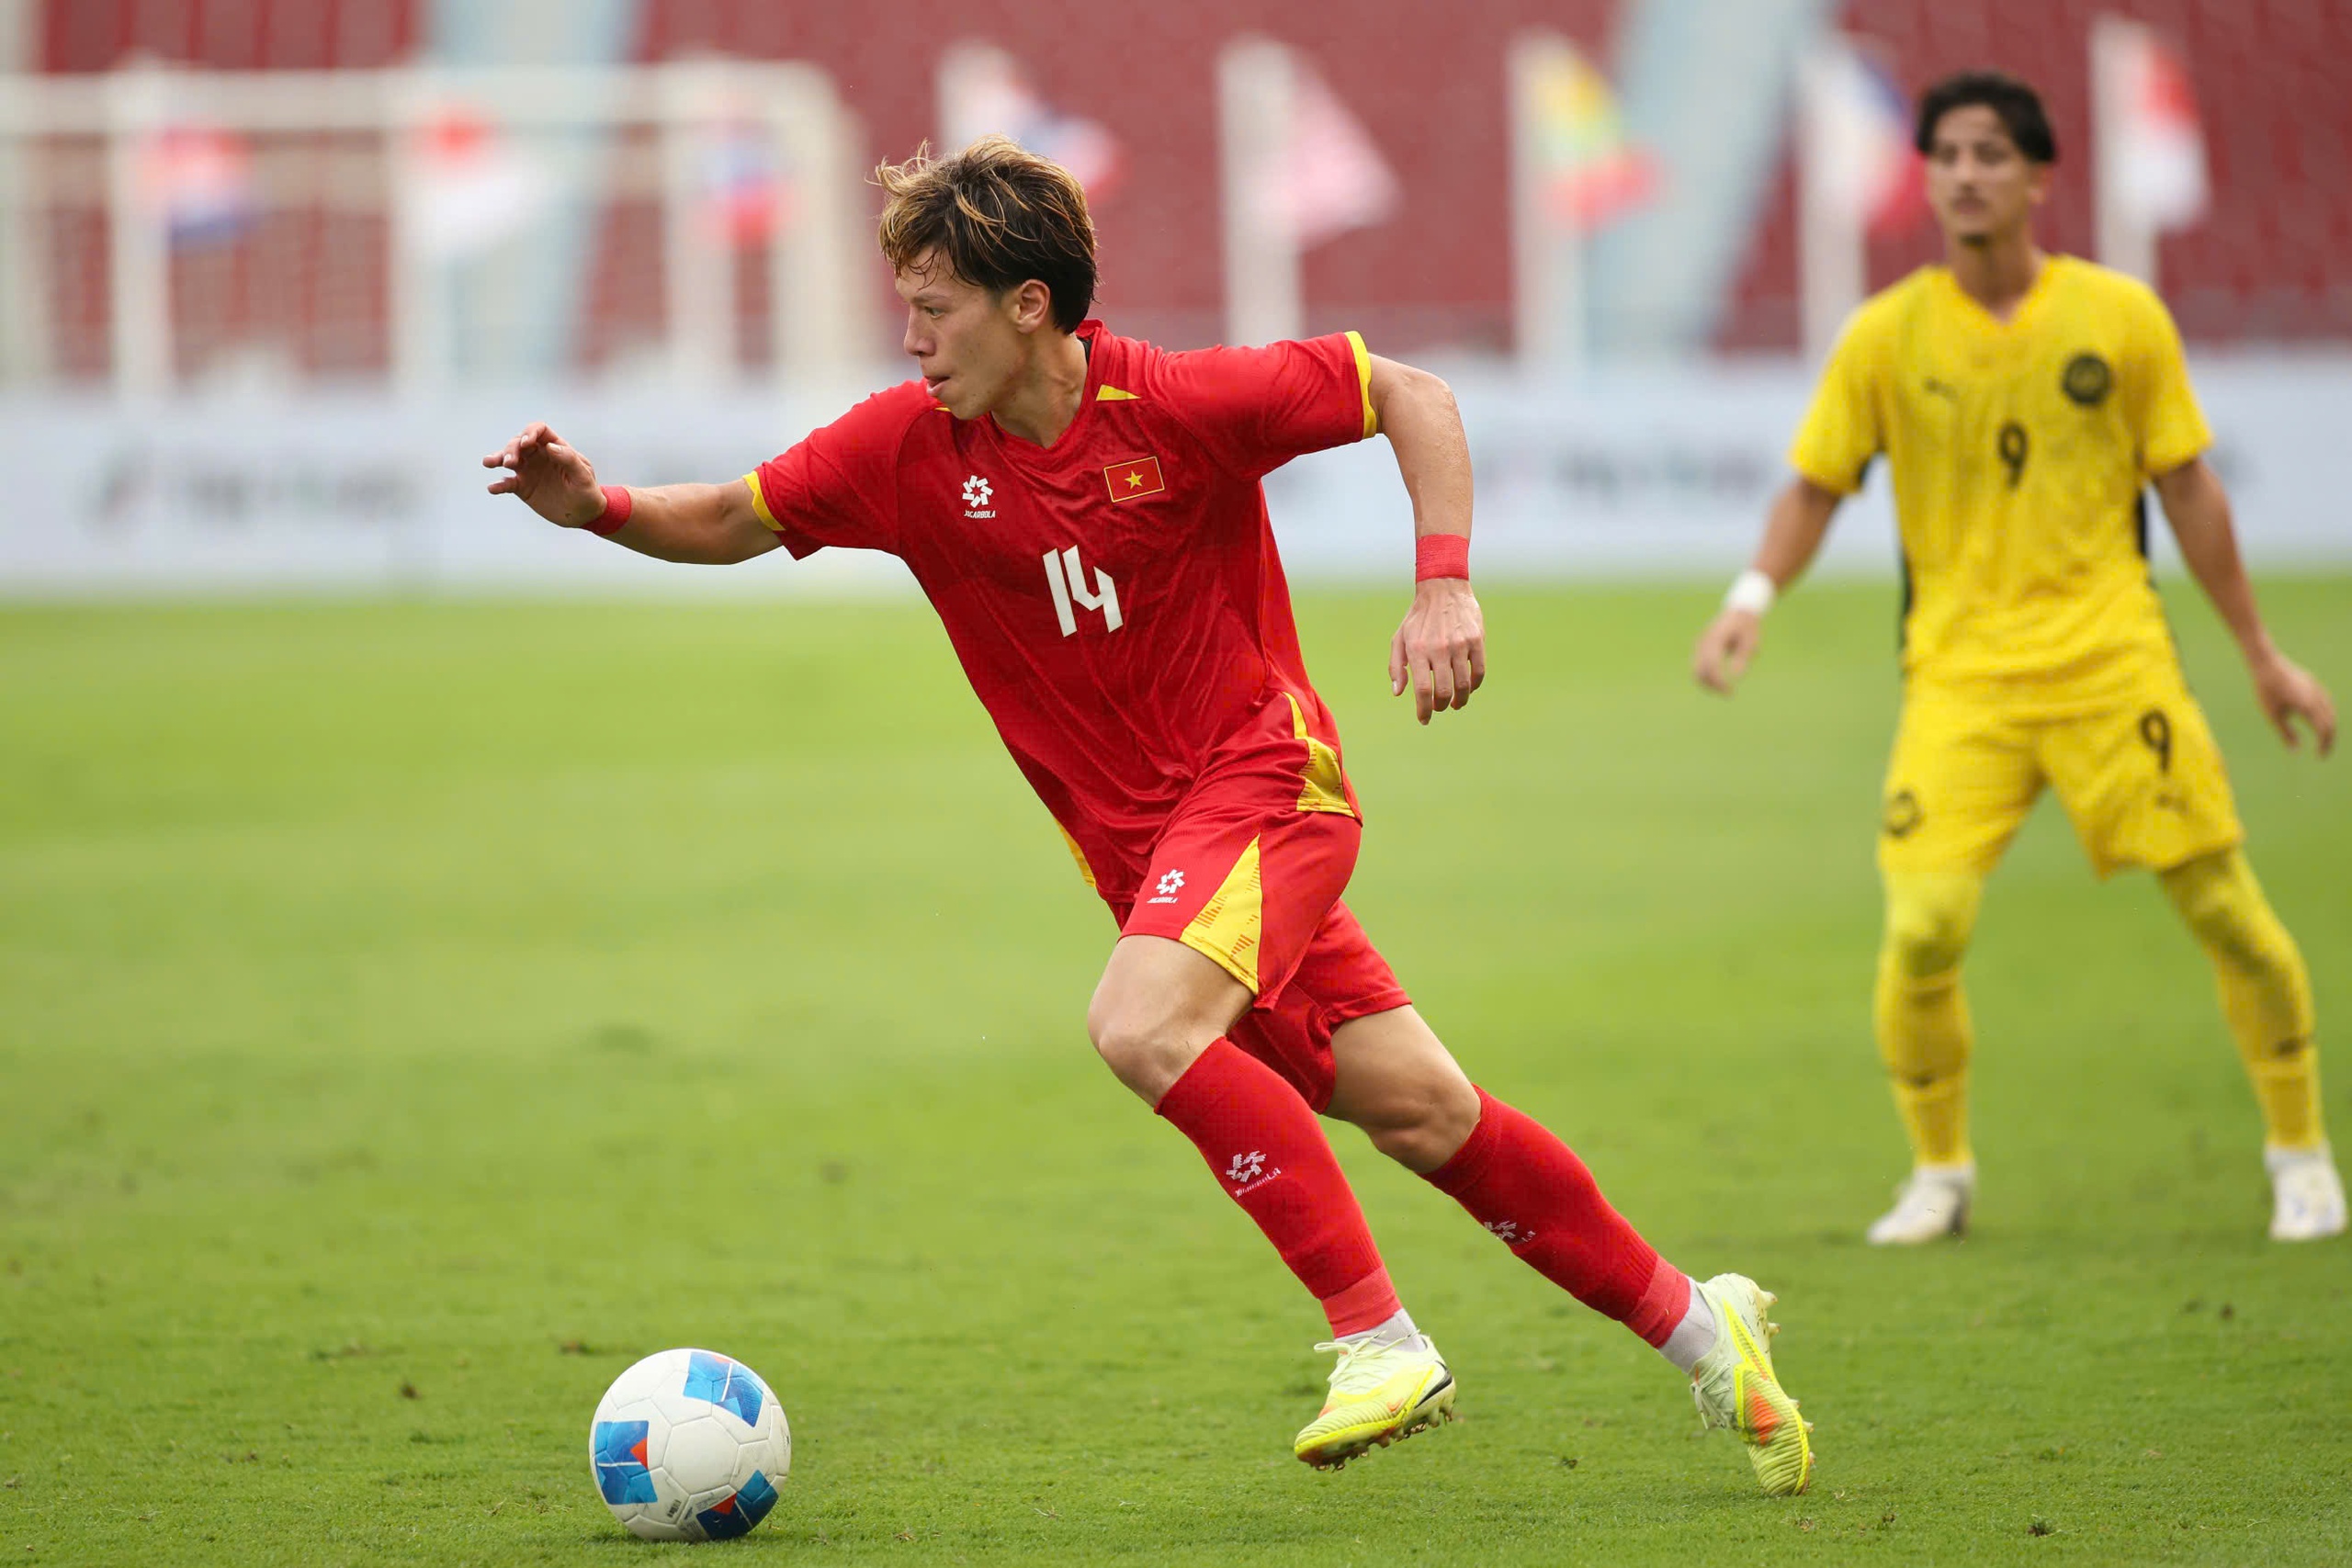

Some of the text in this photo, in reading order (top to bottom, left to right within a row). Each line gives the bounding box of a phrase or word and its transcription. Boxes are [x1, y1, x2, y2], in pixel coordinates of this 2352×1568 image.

[1998, 422, 2029, 489] 9
[1043, 544, 1124, 637] 14
[2139, 709, 2172, 773] 9
